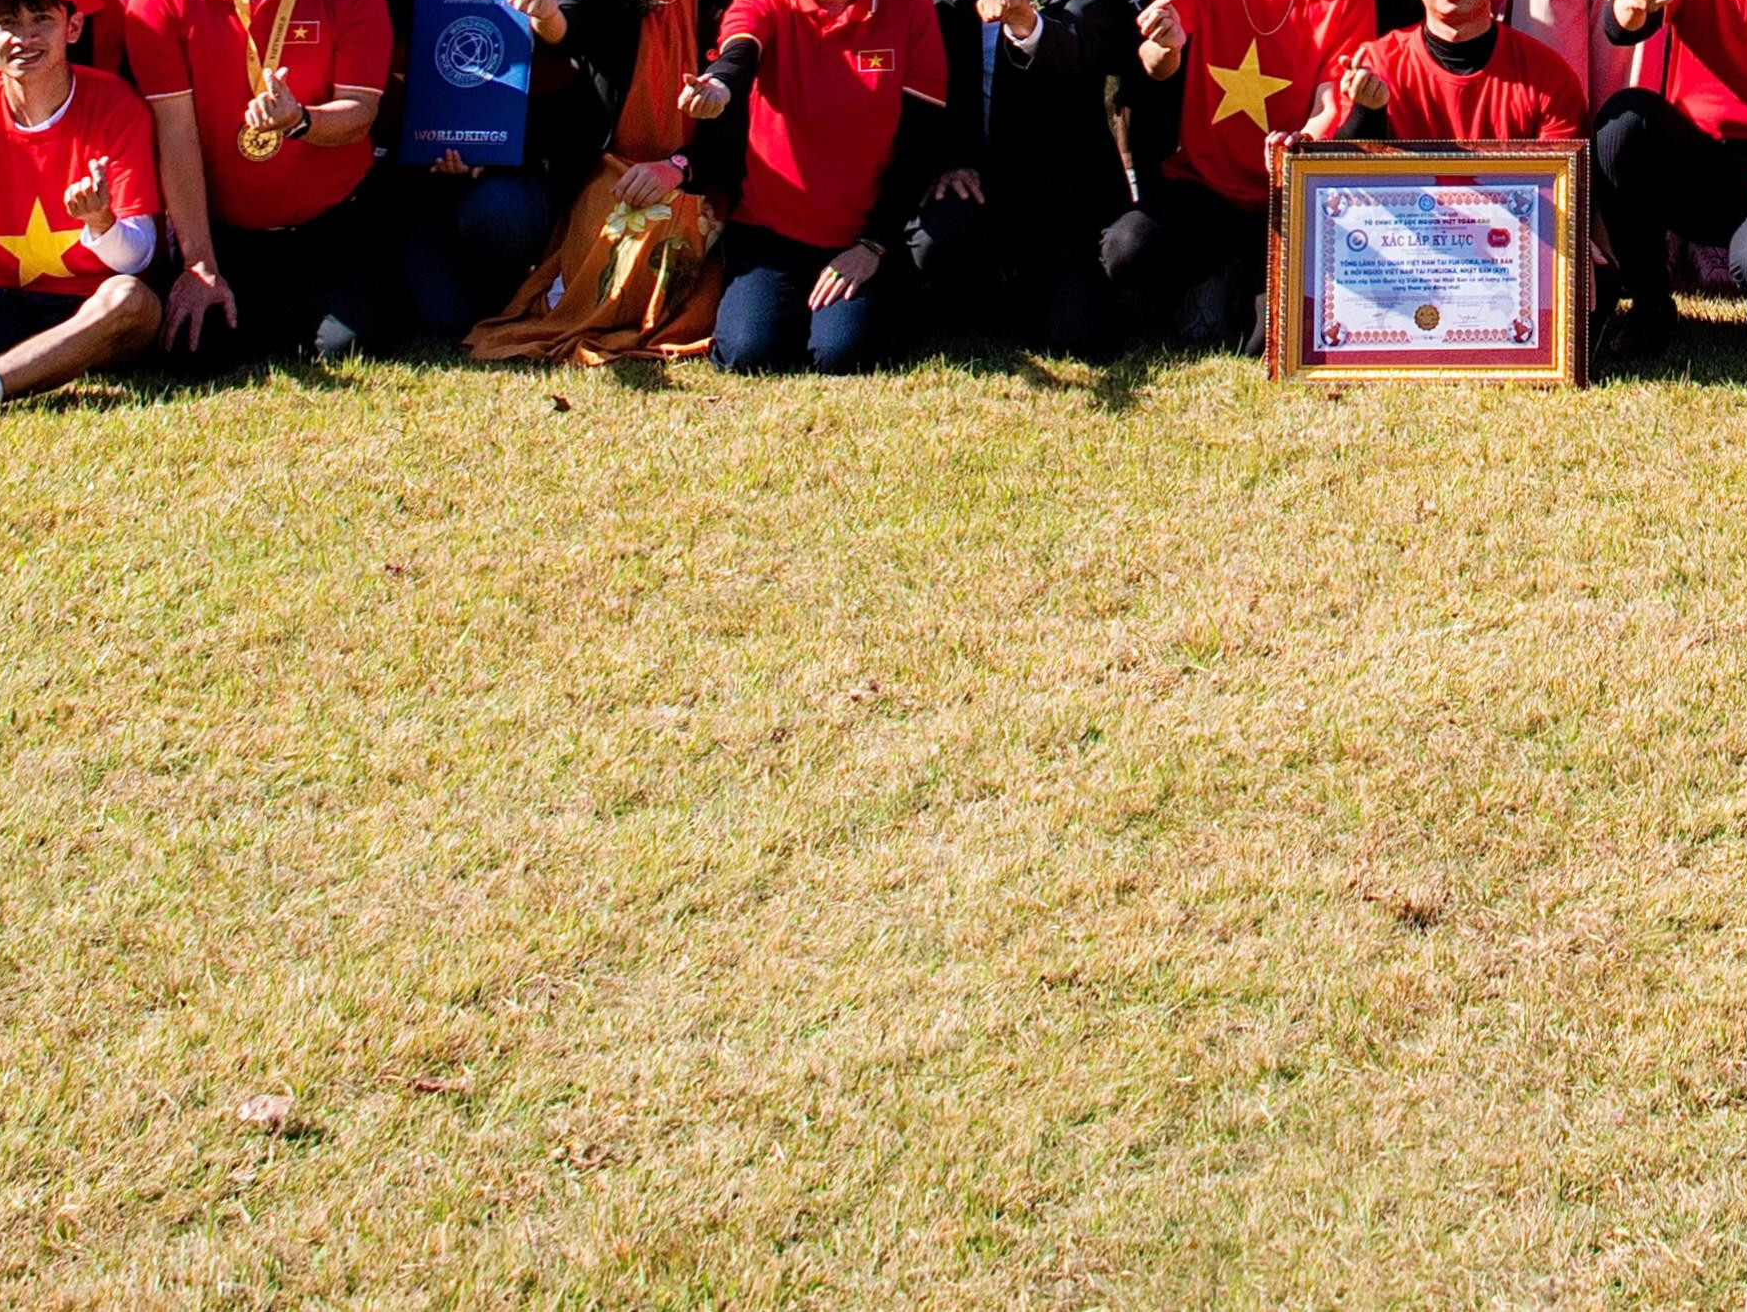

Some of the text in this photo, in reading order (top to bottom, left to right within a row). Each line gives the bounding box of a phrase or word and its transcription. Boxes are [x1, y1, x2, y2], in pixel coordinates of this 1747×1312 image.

[413, 130, 509, 143] WORLDKINGS
[1381, 231, 1405, 247] XÁC
[1408, 232, 1429, 247] LẬP
